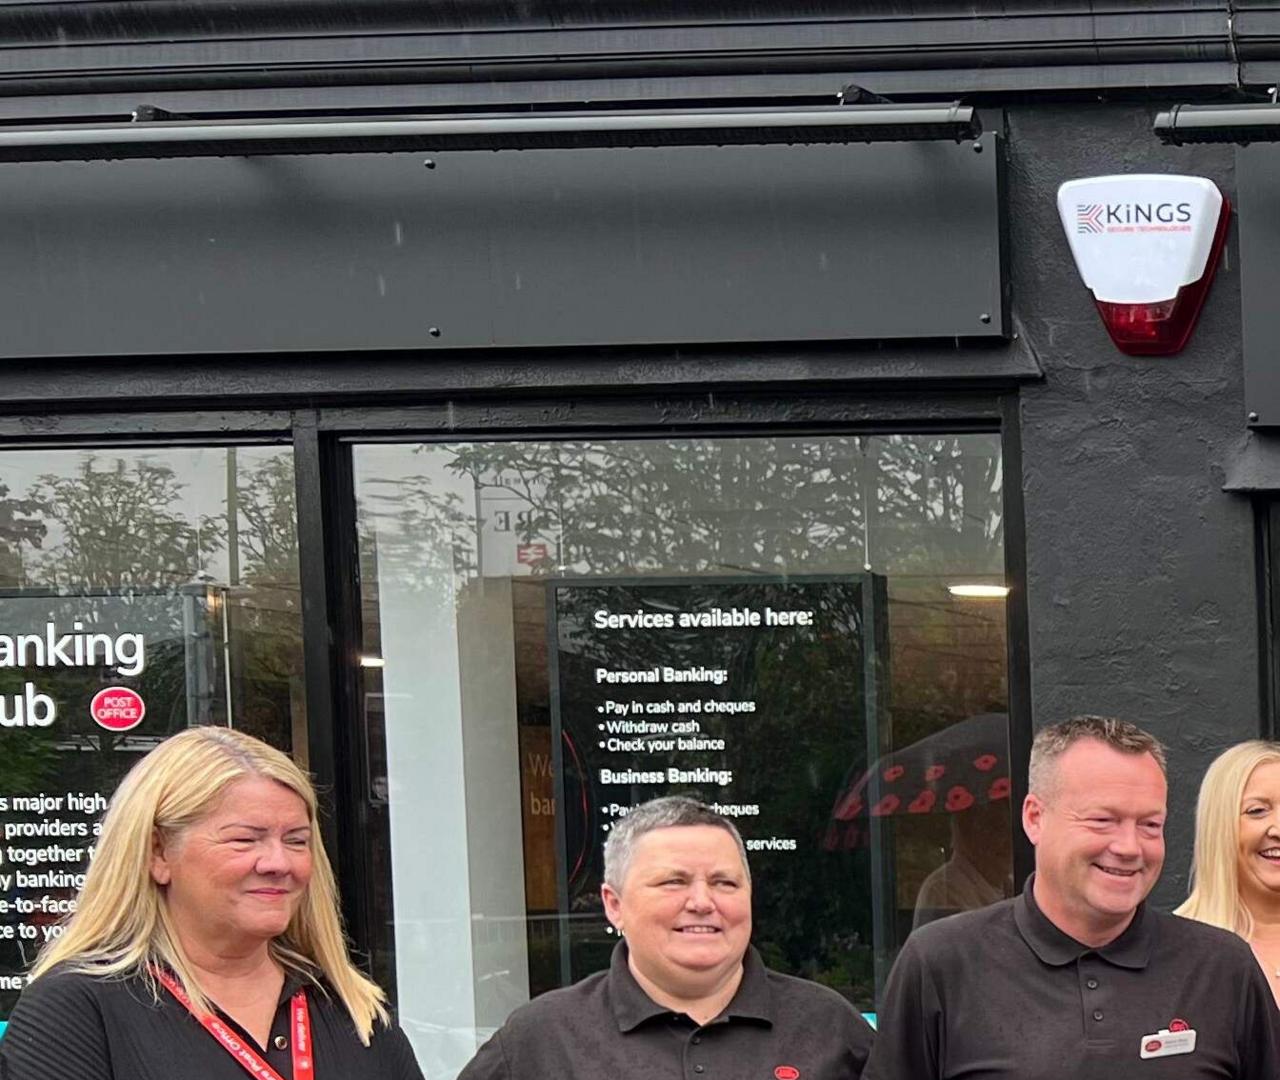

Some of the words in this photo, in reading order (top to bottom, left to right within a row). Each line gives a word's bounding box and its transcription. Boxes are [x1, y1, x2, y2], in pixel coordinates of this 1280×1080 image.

[1107, 202, 1192, 224] KiNGS
[594, 609, 675, 629] Services
[679, 607, 761, 628] available
[765, 607, 814, 626] here:
[596, 667, 660, 684] Personal
[663, 666, 728, 685] Banking:
[103, 696, 133, 708] POST
[605, 701, 630, 716] Pay
[631, 701, 644, 714] in
[646, 699, 676, 714] cash
[677, 699, 702, 714] and
[704, 699, 756, 715] cheques
[97, 708, 138, 719] OFFICE
[606, 720, 669, 734] Withdraw
[671, 719, 700, 733] cash
[607, 737, 646, 752] Check
[648, 740, 676, 754] your
[678, 737, 726, 750] balance
[600, 768, 665, 785] Business
[668, 767, 733, 786] Banking:
[12, 793, 64, 814] major
[67, 792, 107, 814] high
[5, 819, 88, 840] providers
[746, 837, 797, 851] services
[7, 844, 84, 866] together
[16, 870, 86, 891] banking
[18, 922, 37, 939] to
[211, 1021, 242, 1052] Office
[241, 1047, 263, 1072] Post
